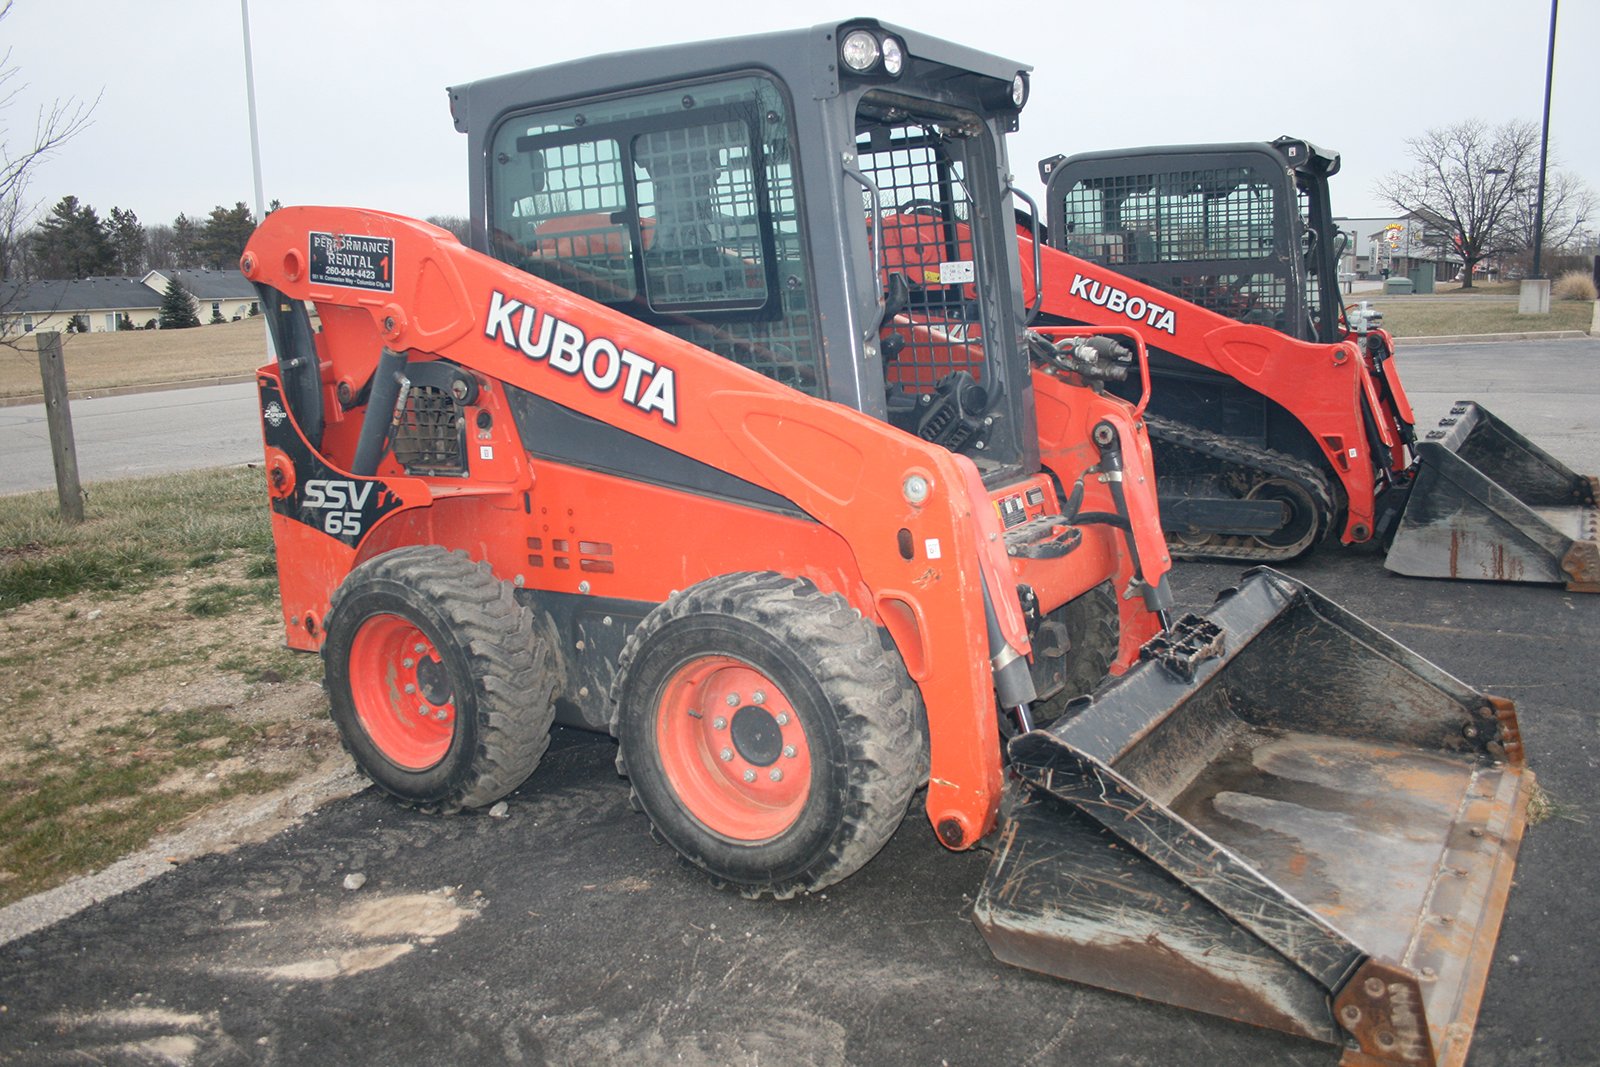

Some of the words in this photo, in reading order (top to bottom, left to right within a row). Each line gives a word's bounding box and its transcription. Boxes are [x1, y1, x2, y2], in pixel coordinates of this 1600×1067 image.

[325, 266, 375, 279] 260-244-4423
[328, 254, 374, 269] RENTAL
[380, 256, 389, 281] 1
[1069, 273, 1176, 335] KUBOTA
[484, 289, 677, 426] KUBOTA
[302, 479, 374, 510] SSV
[324, 510, 362, 536] 65
